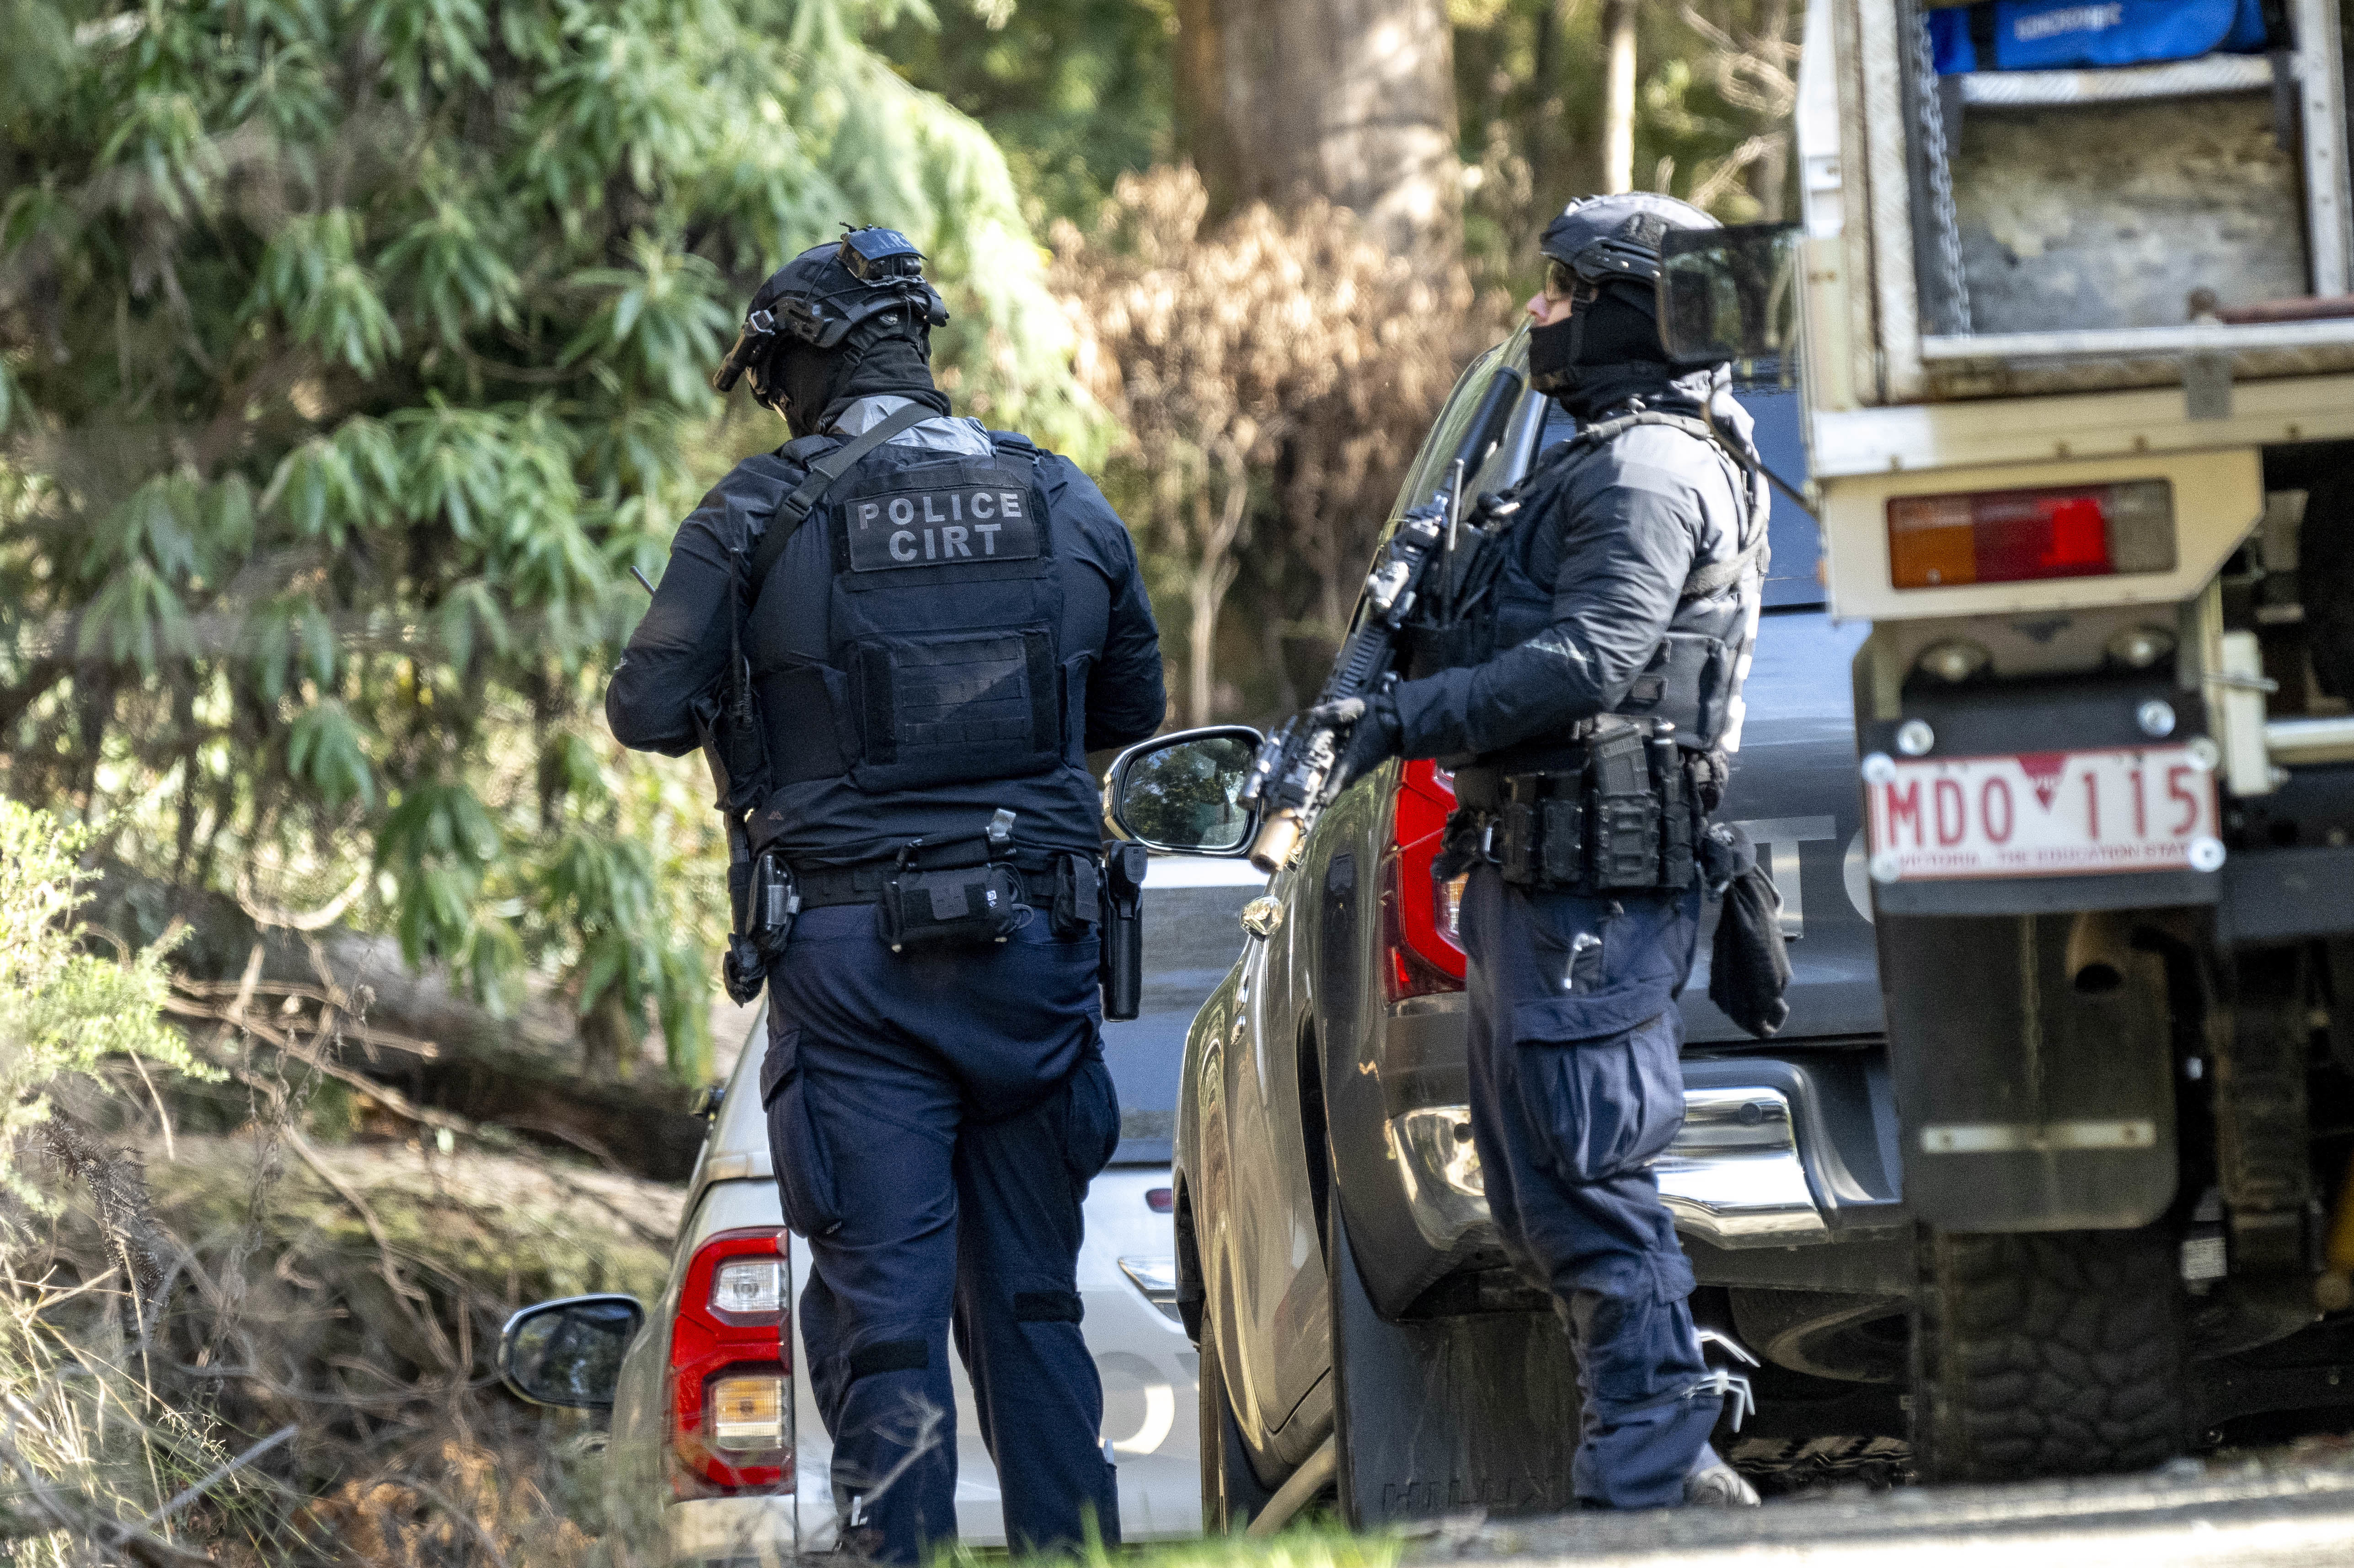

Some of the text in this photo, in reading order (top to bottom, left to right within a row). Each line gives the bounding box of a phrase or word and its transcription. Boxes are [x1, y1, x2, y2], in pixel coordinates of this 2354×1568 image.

[858, 492, 1022, 530] POLICE
[889, 523, 1002, 562] CIRT
[1886, 765, 2201, 848] MDO 115
